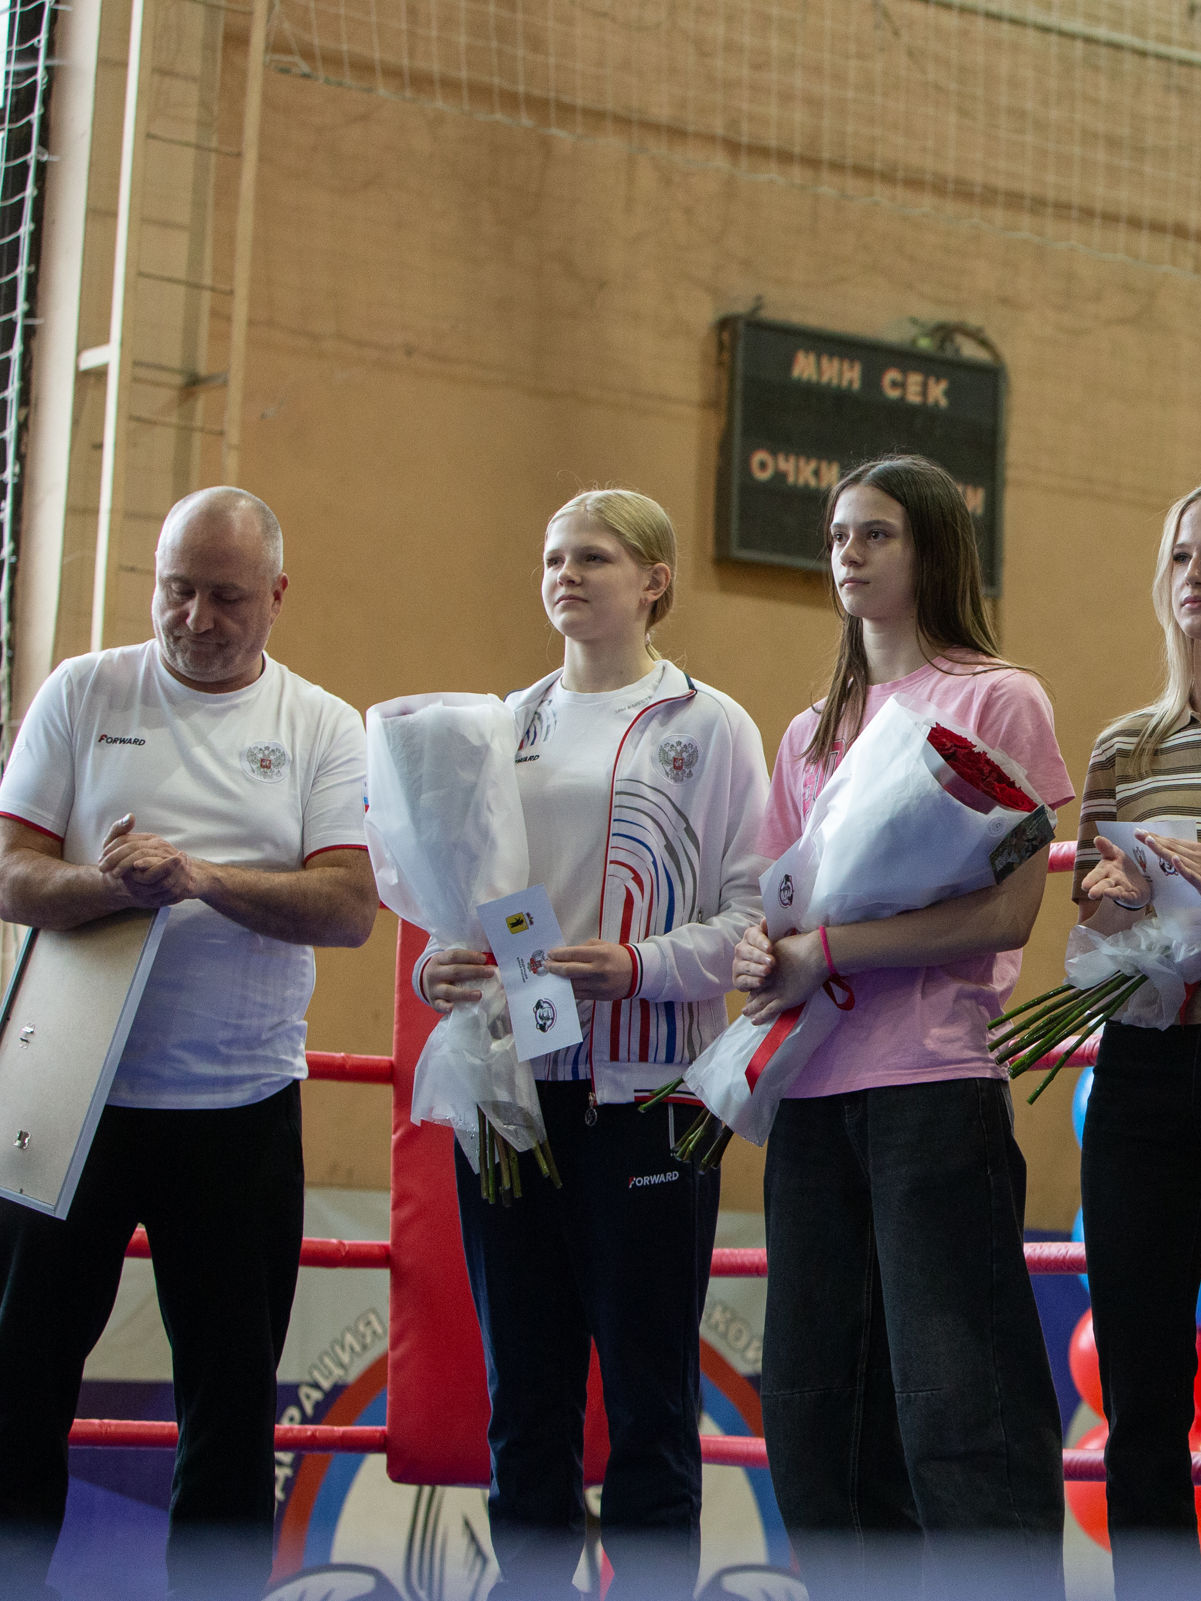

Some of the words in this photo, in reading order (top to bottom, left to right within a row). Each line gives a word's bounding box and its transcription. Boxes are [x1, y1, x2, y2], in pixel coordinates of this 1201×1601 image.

[791, 349, 862, 391] МИН
[881, 367, 949, 408] СЕК
[751, 448, 840, 490] ОЧКИ
[98, 734, 146, 746] FORWARD
[628, 1171, 680, 1189] FORWARD
